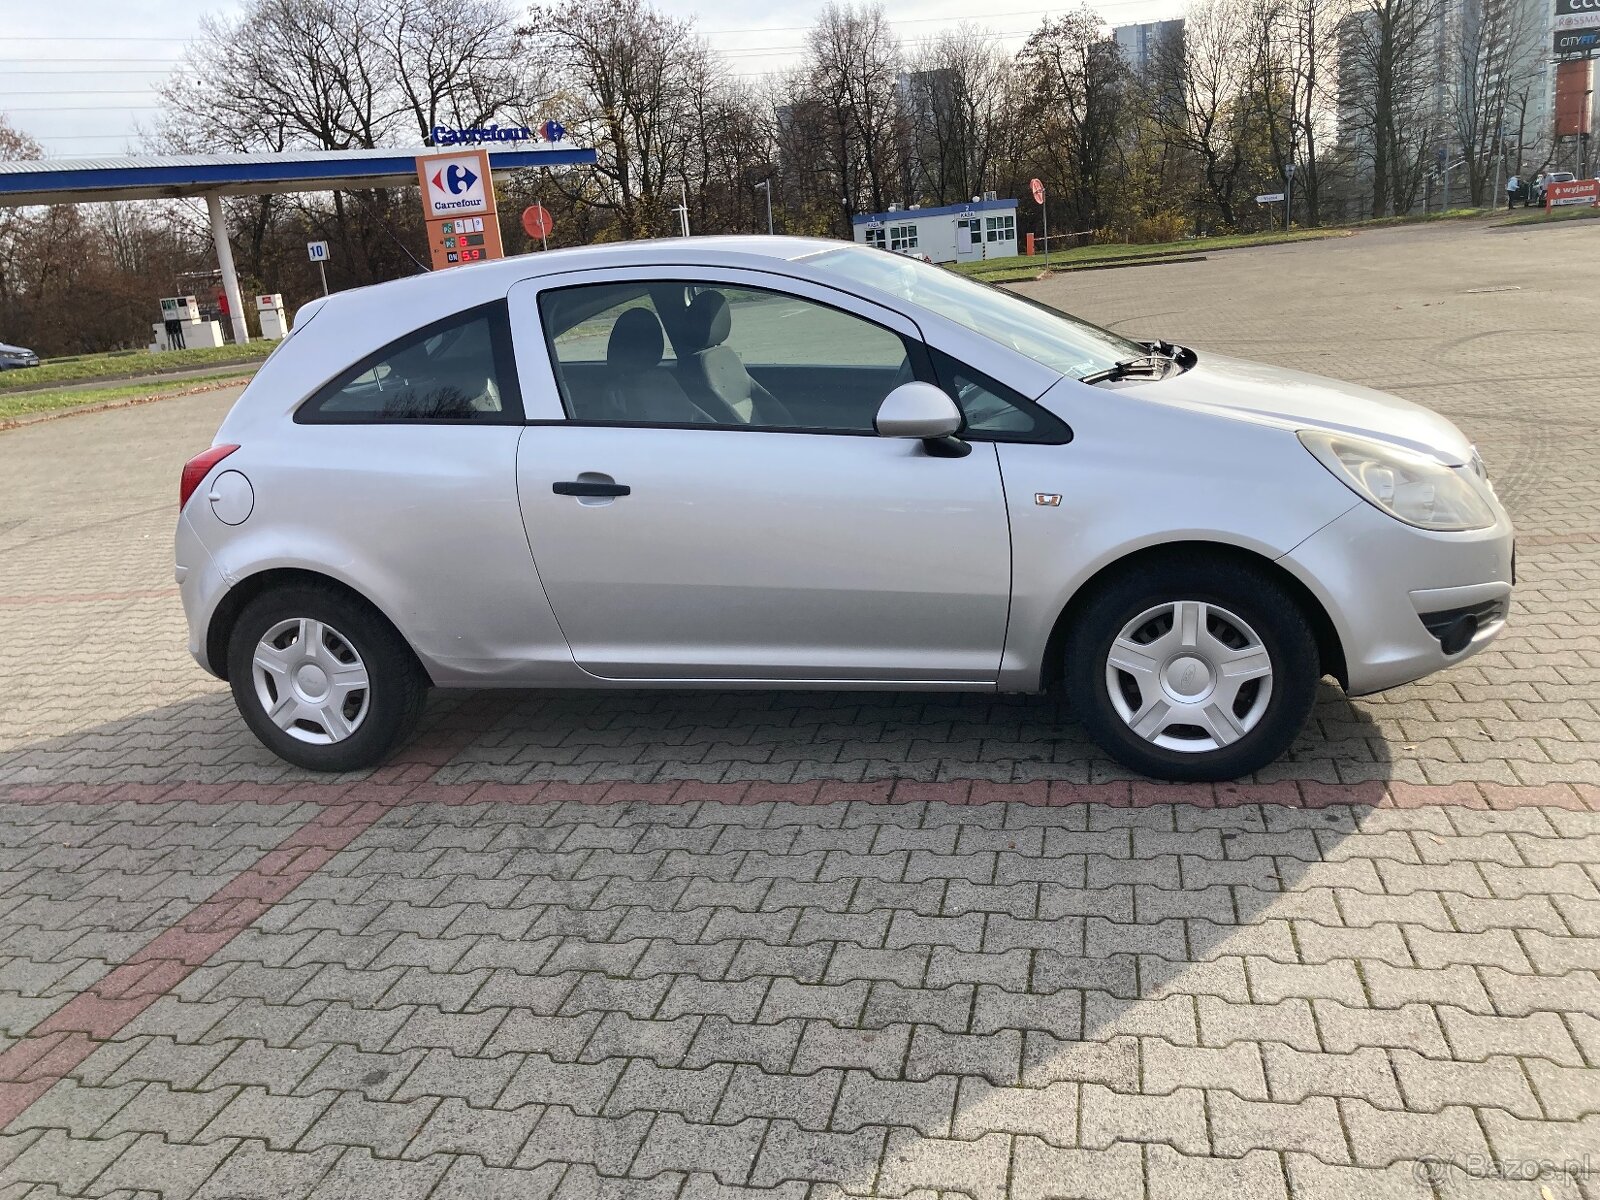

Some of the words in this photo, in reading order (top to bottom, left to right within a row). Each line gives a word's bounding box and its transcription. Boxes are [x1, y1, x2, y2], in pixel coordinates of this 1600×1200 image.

[432, 124, 530, 144] Carrefour
[1562, 184, 1595, 194] wyjazd
[434, 199, 481, 210] Carrefour
[310, 245, 323, 257] 10
